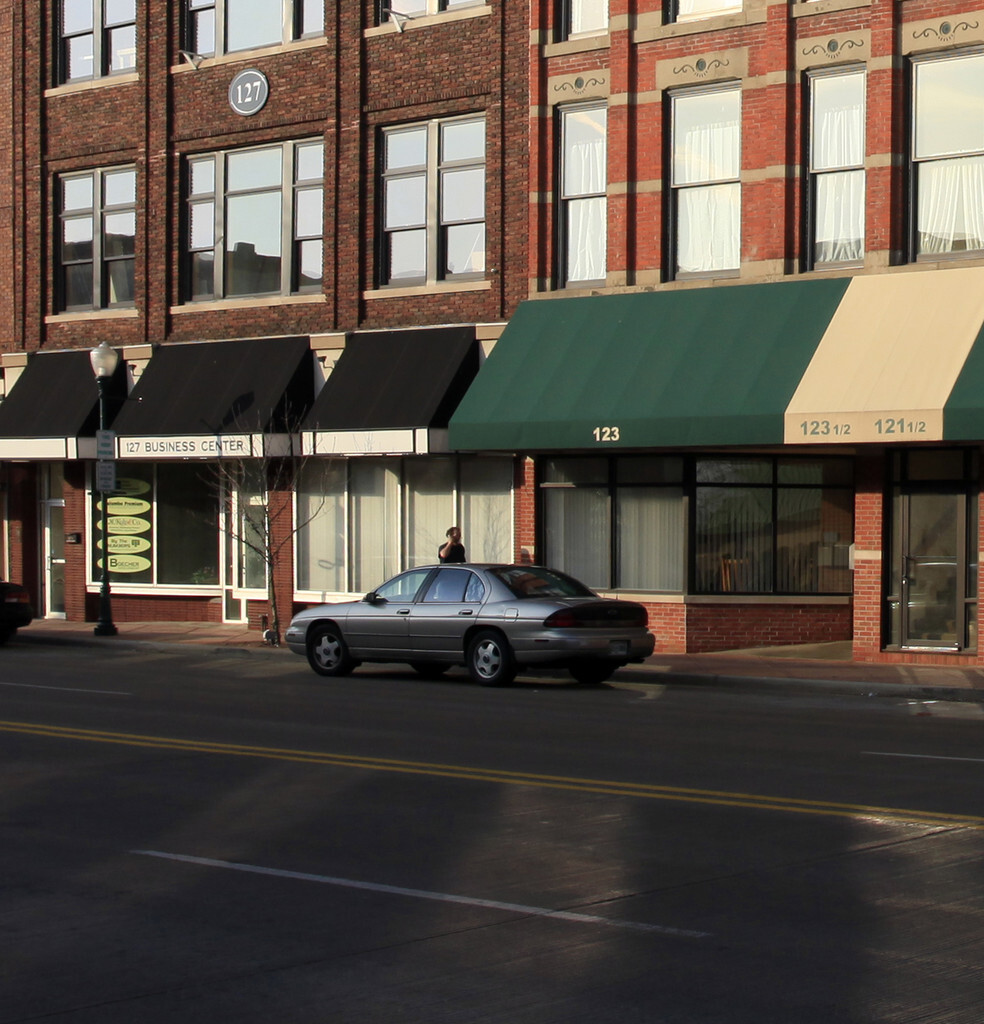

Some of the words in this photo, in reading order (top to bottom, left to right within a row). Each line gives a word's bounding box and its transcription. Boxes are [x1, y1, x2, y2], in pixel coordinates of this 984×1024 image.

[237, 80, 262, 104] 127
[592, 426, 620, 442] 123
[799, 420, 831, 436] 123
[833, 423, 851, 436] 1/2
[874, 417, 905, 435] 121
[125, 441, 141, 453] 127
[145, 440, 196, 453] BUSINESS
[200, 440, 244, 452] CENTER
